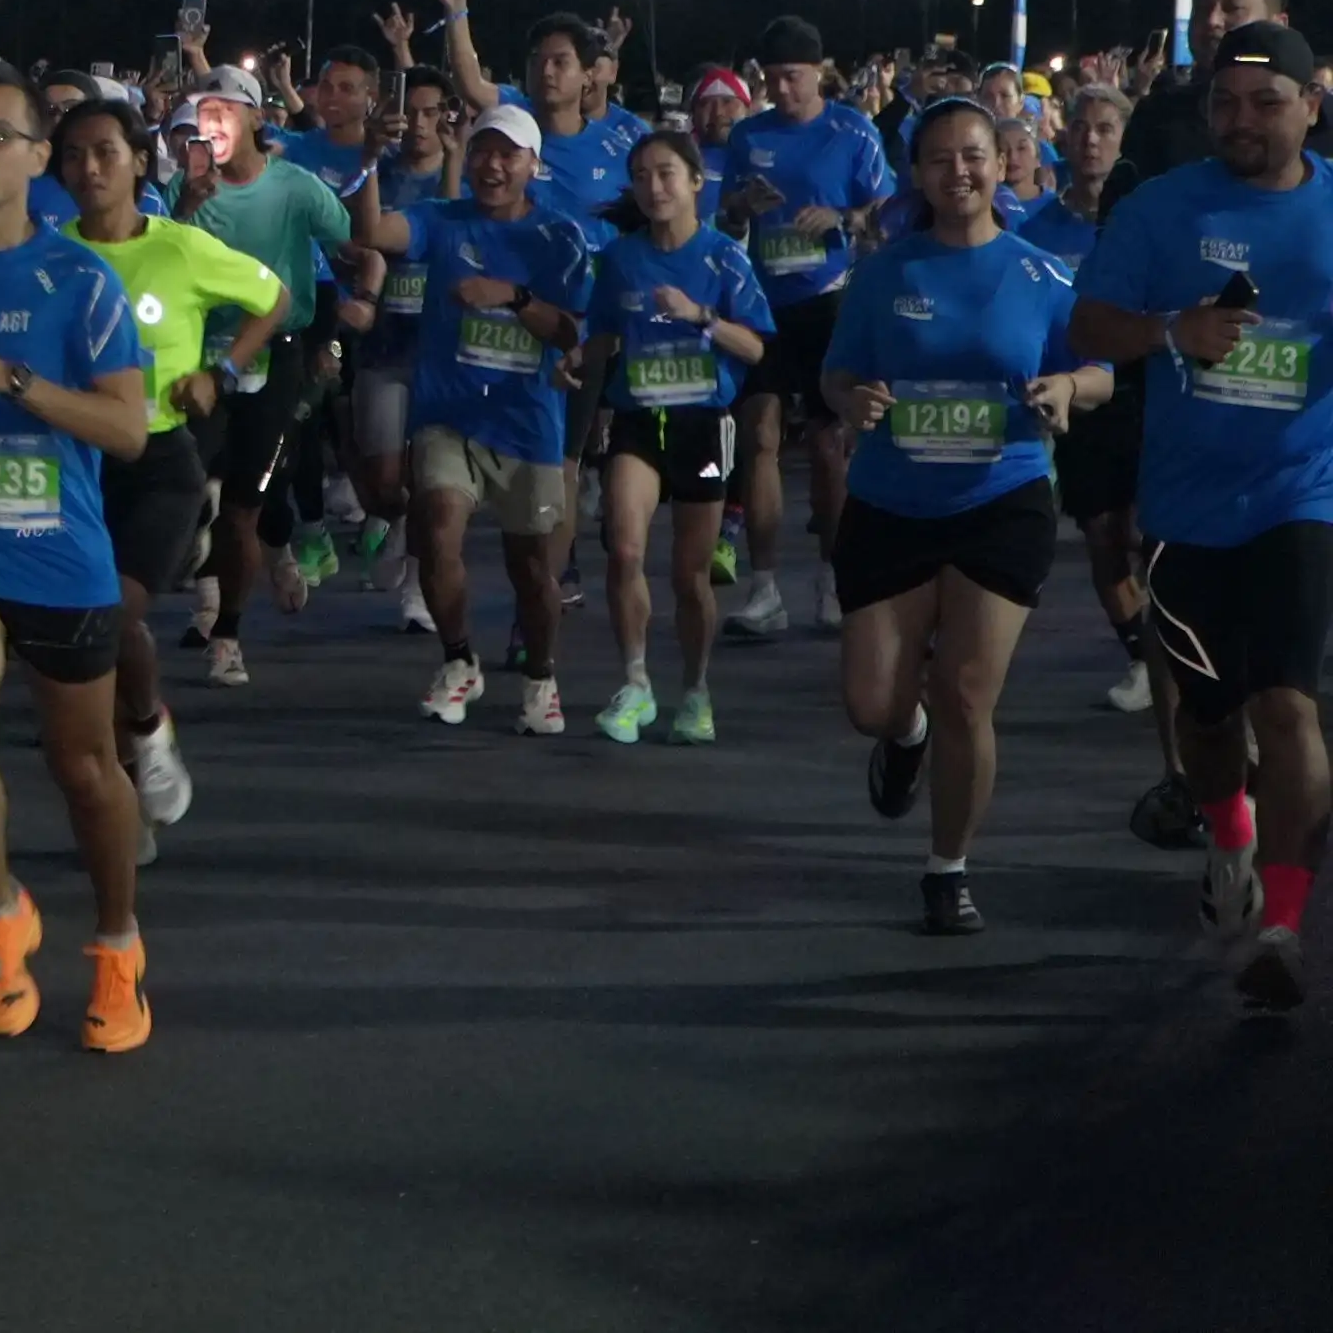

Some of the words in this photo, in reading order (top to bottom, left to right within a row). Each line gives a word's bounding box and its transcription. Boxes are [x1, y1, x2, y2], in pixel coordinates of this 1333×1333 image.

[393, 276, 427, 296] 109
[471, 322, 532, 351] 12140
[1217, 341, 1298, 378] 243
[907, 403, 992, 435] 12194
